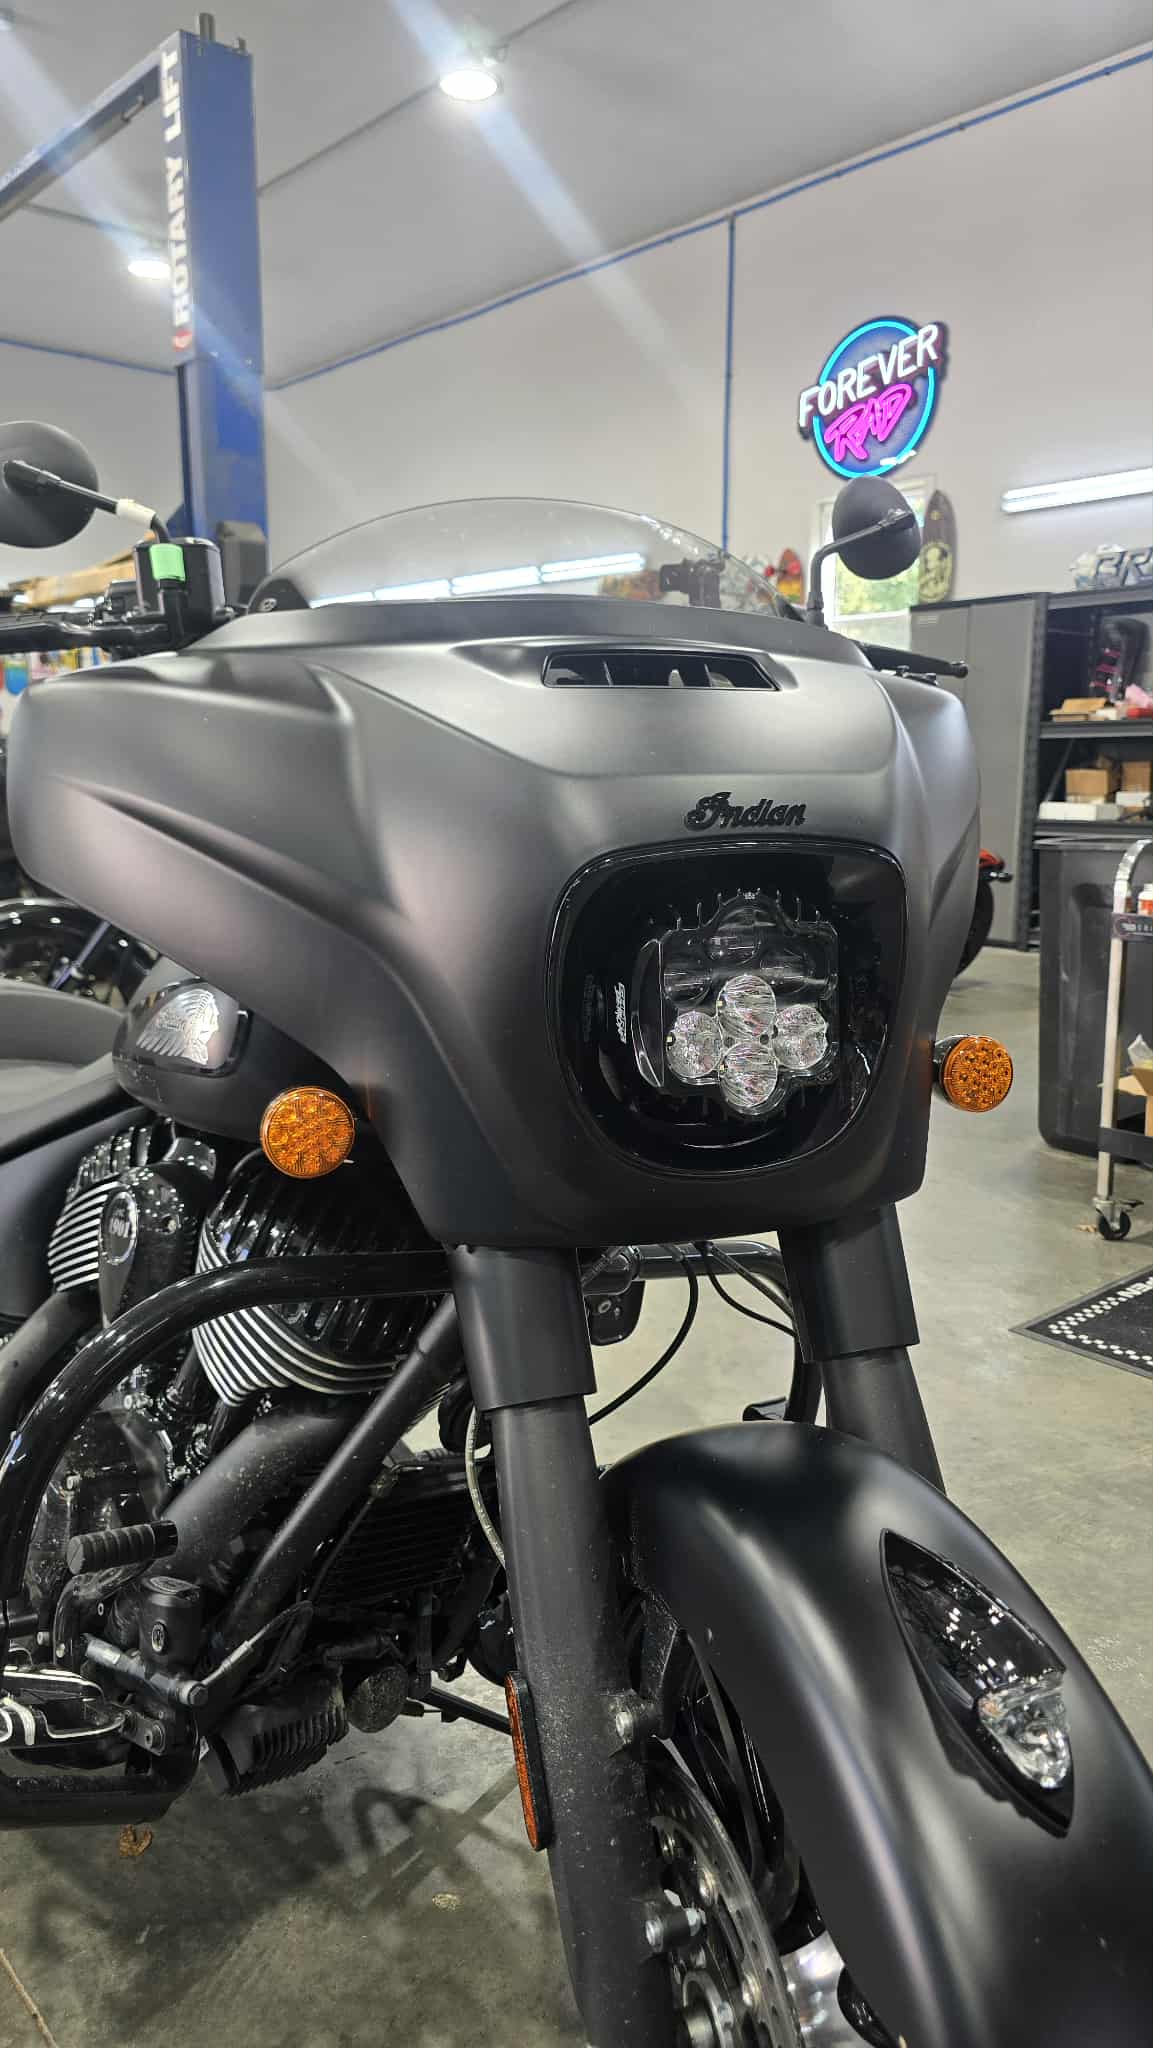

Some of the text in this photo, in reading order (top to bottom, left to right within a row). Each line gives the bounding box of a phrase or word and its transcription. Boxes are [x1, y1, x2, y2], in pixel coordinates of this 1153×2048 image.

[161, 51, 189, 327] ROTARY LIFT
[799, 323, 939, 428] FOREVER
[824, 383, 912, 462] RAD
[684, 791, 807, 831] Indian
